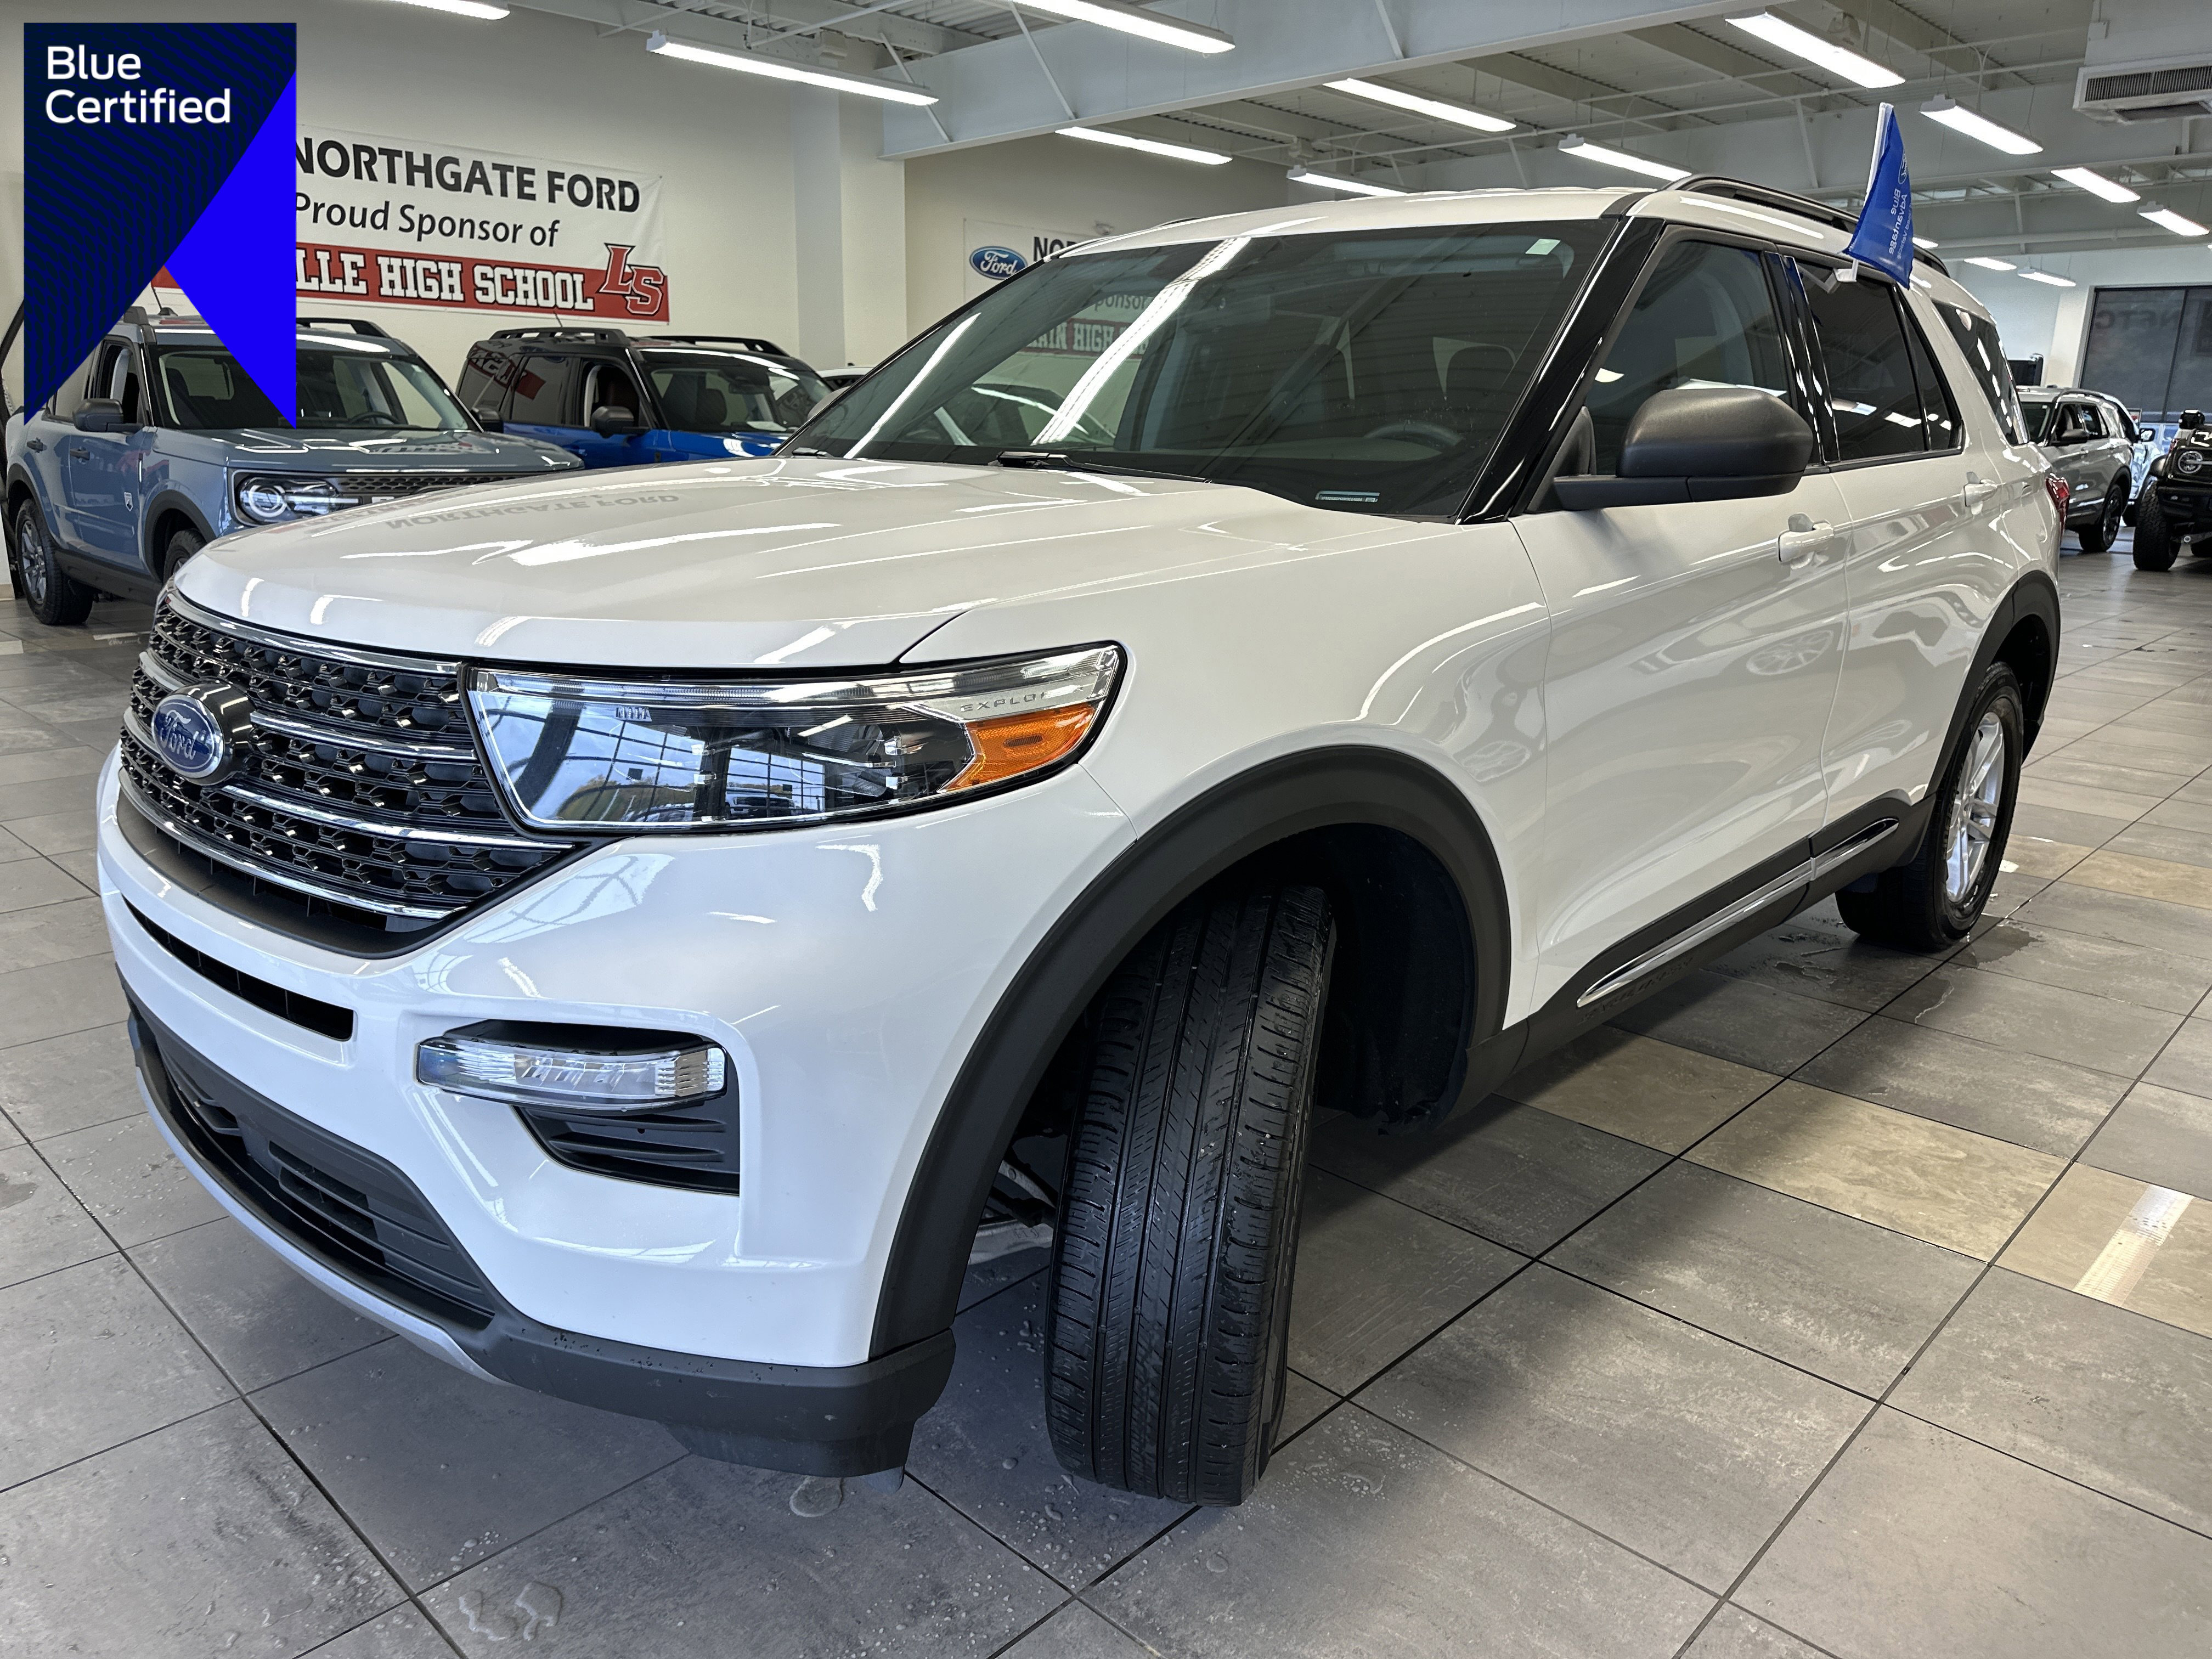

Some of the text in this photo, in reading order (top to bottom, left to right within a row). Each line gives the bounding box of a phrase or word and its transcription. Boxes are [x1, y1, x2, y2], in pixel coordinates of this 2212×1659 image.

[296, 137, 640, 213] NORTHGATE FORD
[296, 192, 561, 248] Proud Sponsor of
[980, 250, 1018, 275] Ford
[1034, 236, 1077, 262] NO
[296, 247, 596, 312] LLE HIGH SCHOOL
[1095, 295, 1147, 312] ponsor
[1074, 323, 1114, 352] HIGH
[960, 686, 1084, 713] EXPLO
[160, 709, 199, 760] Ford
